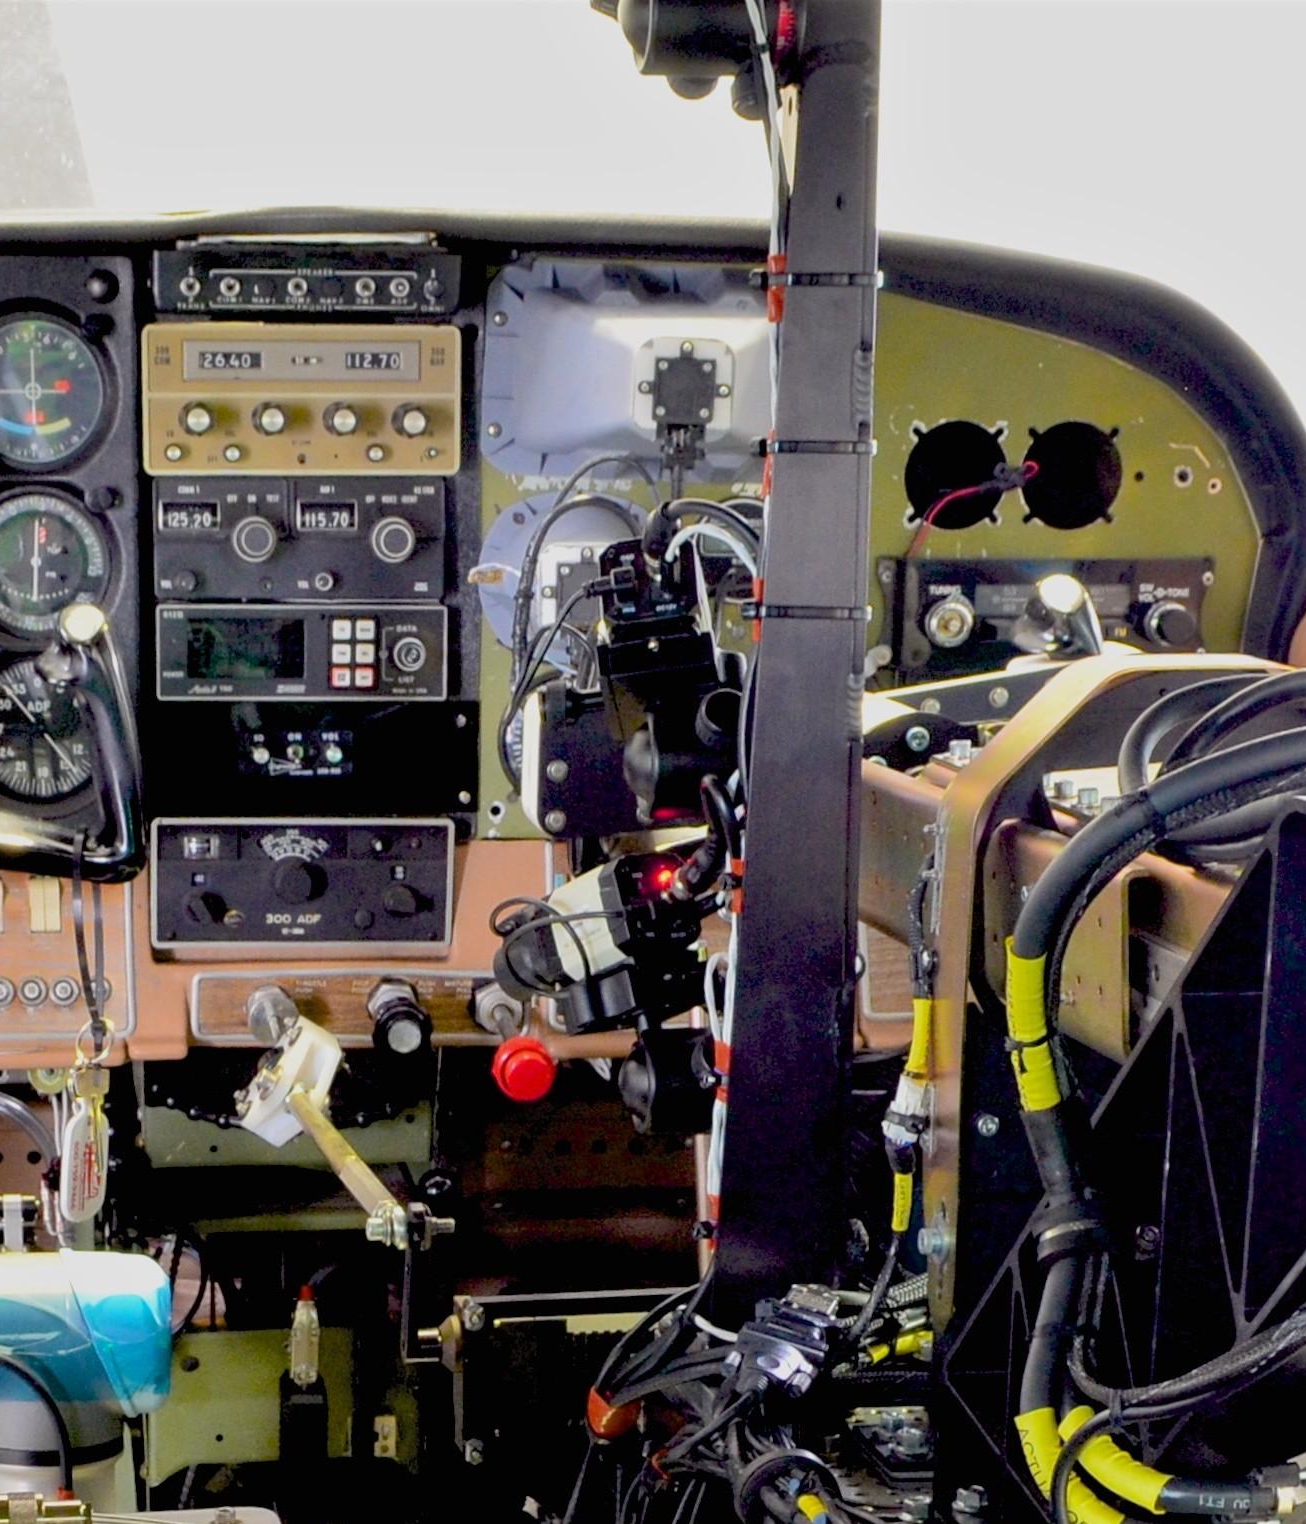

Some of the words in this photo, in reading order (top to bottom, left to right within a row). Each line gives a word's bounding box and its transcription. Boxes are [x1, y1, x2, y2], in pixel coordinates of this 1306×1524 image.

[346, 353, 400, 368] 112.70
[304, 511, 350, 528] 115.70
[27, 700, 51, 713] ADF
[287, 731, 303, 742] ON
[321, 731, 340, 742] VOL
[0, 745, 15, 759] 24
[265, 912, 292, 925] 300
[296, 913, 322, 925] ADF
